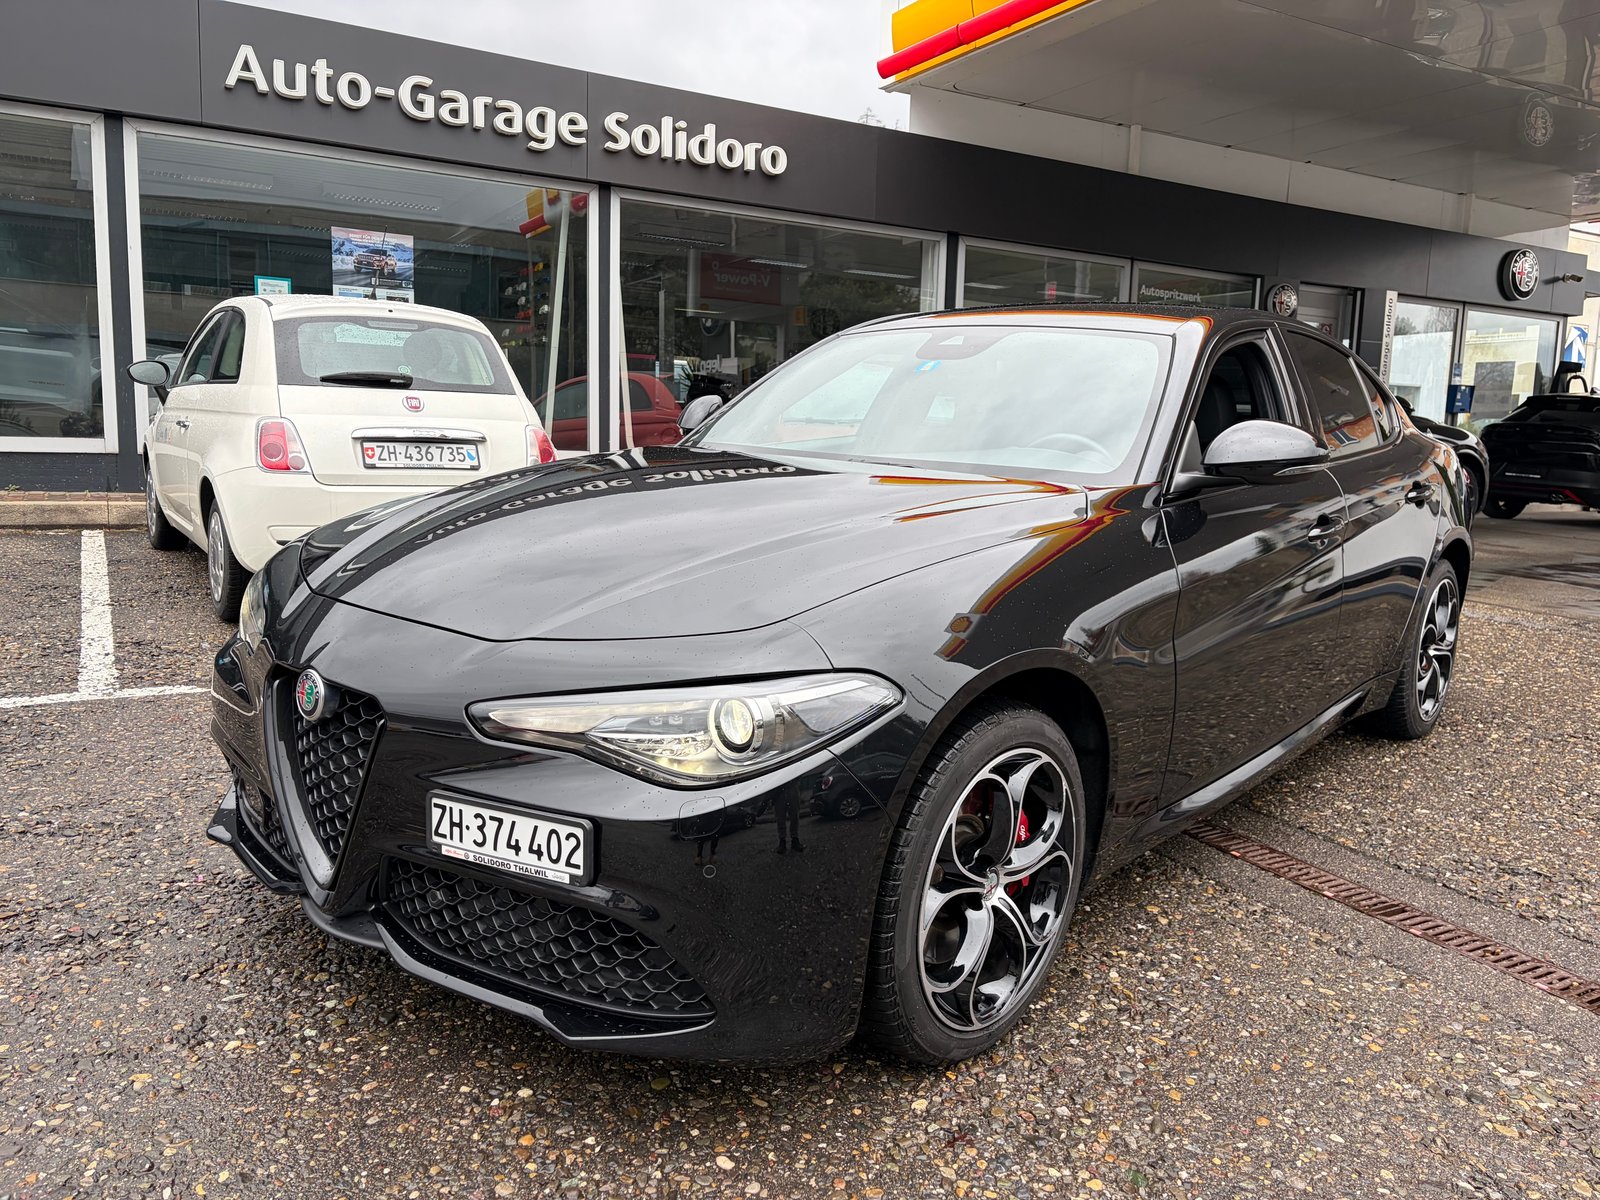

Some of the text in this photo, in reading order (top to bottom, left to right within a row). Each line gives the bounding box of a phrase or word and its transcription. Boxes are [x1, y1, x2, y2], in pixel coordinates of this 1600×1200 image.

[224, 44, 788, 176] Auto-Garage Solidoro
[1139, 284, 1202, 303] Autospritzwerk
[472, 854, 549, 878] SOLIDORO THALWIL
